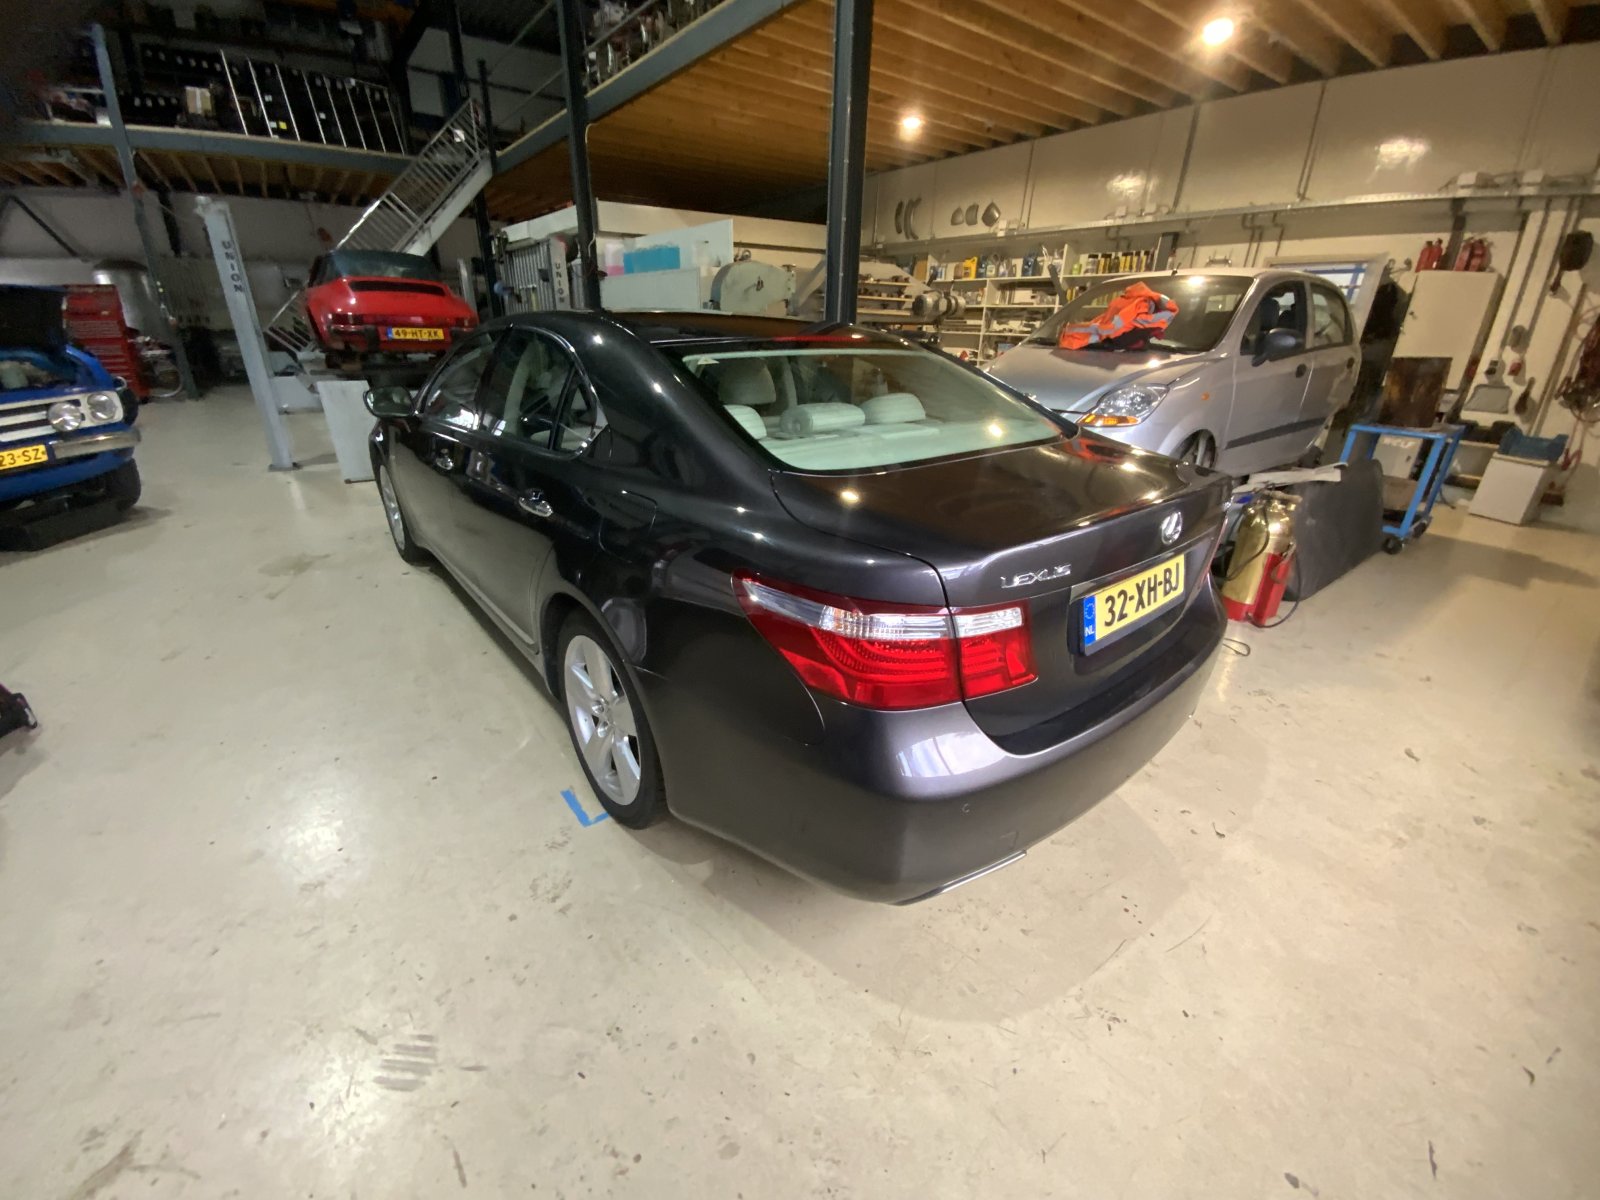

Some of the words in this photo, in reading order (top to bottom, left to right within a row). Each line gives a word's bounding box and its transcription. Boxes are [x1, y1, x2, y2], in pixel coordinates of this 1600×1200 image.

[222, 241, 244, 292] UNION
[555, 262, 565, 303] UNION
[1000, 564, 1071, 588] LEXUS
[1104, 562, 1180, 627] 32-XH-BJ
[1084, 625, 1095, 637] NL
